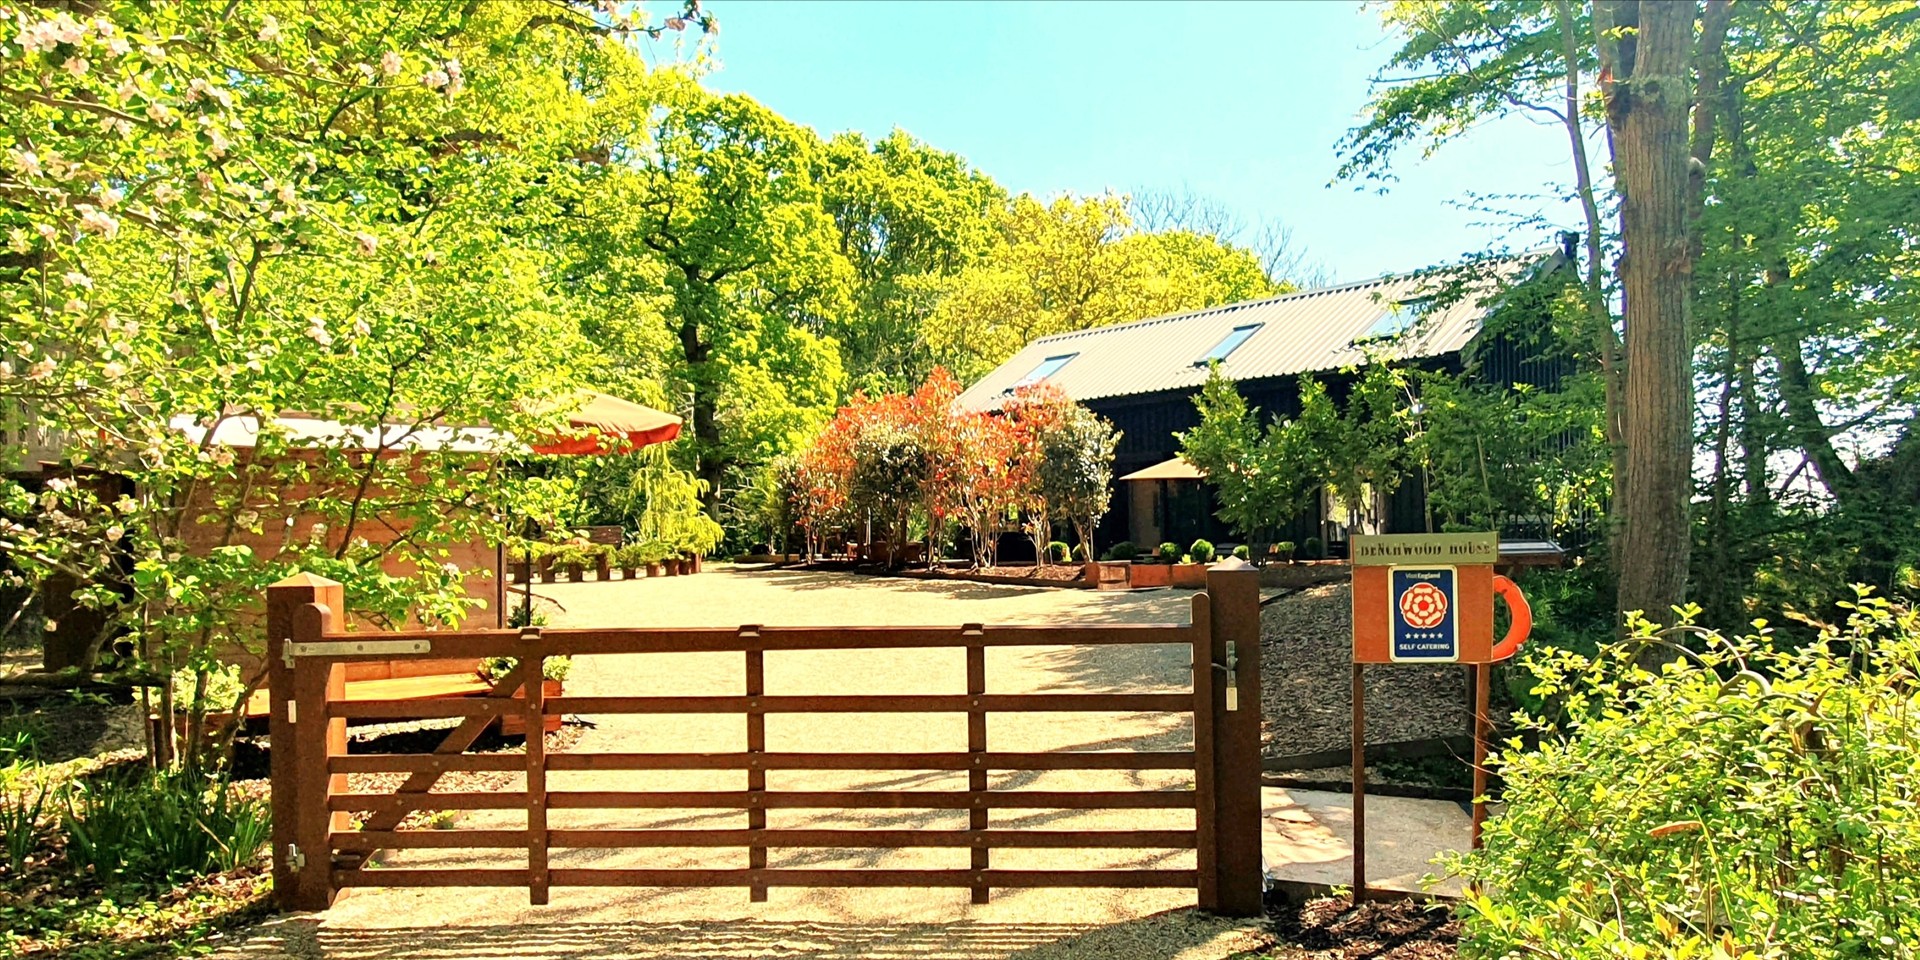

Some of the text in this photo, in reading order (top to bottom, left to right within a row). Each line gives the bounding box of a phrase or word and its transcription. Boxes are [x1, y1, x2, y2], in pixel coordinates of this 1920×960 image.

[1449, 541, 1491, 555] HOUSE
[1399, 643, 1450, 651] SELF CATERING
